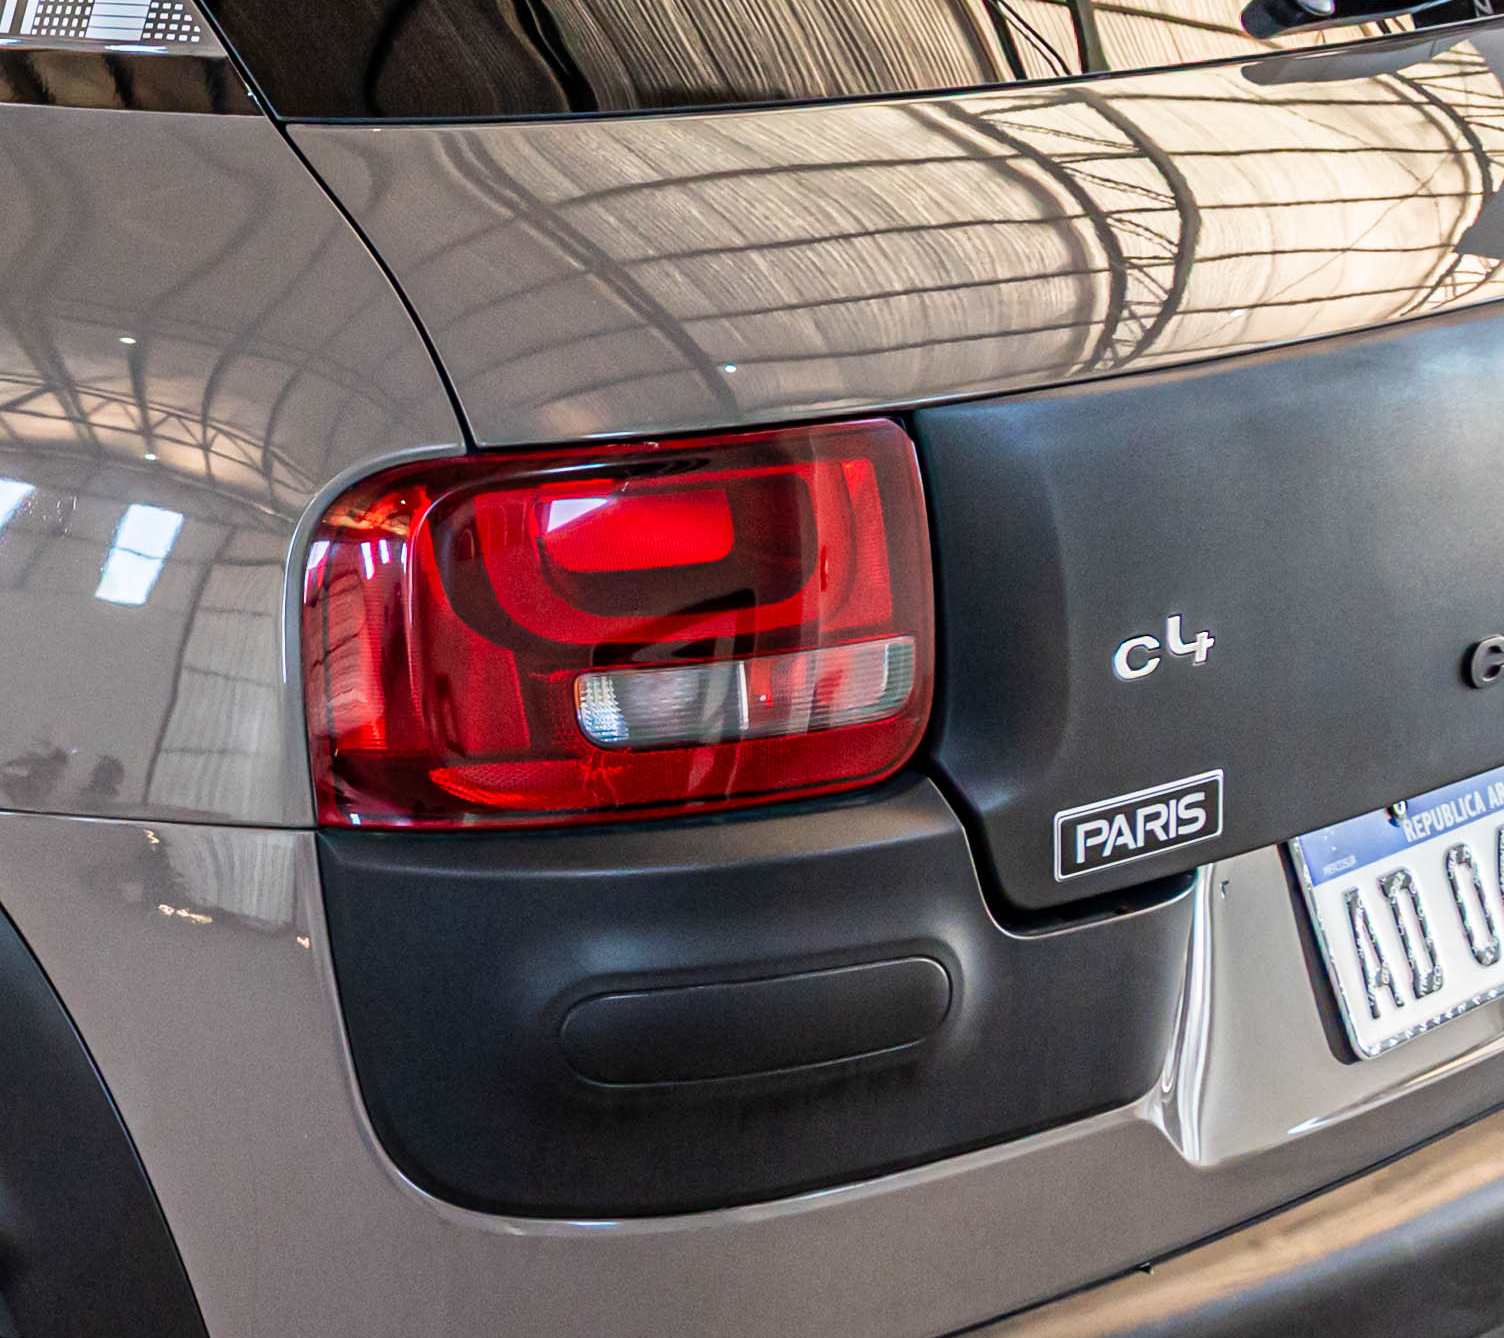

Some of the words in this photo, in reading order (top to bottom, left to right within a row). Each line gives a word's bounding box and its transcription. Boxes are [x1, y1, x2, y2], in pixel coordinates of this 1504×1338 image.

[1076, 792, 1207, 863] PARIS
[1402, 791, 1487, 843] REPUBLICA
[1344, 867, 1444, 1020] AD
